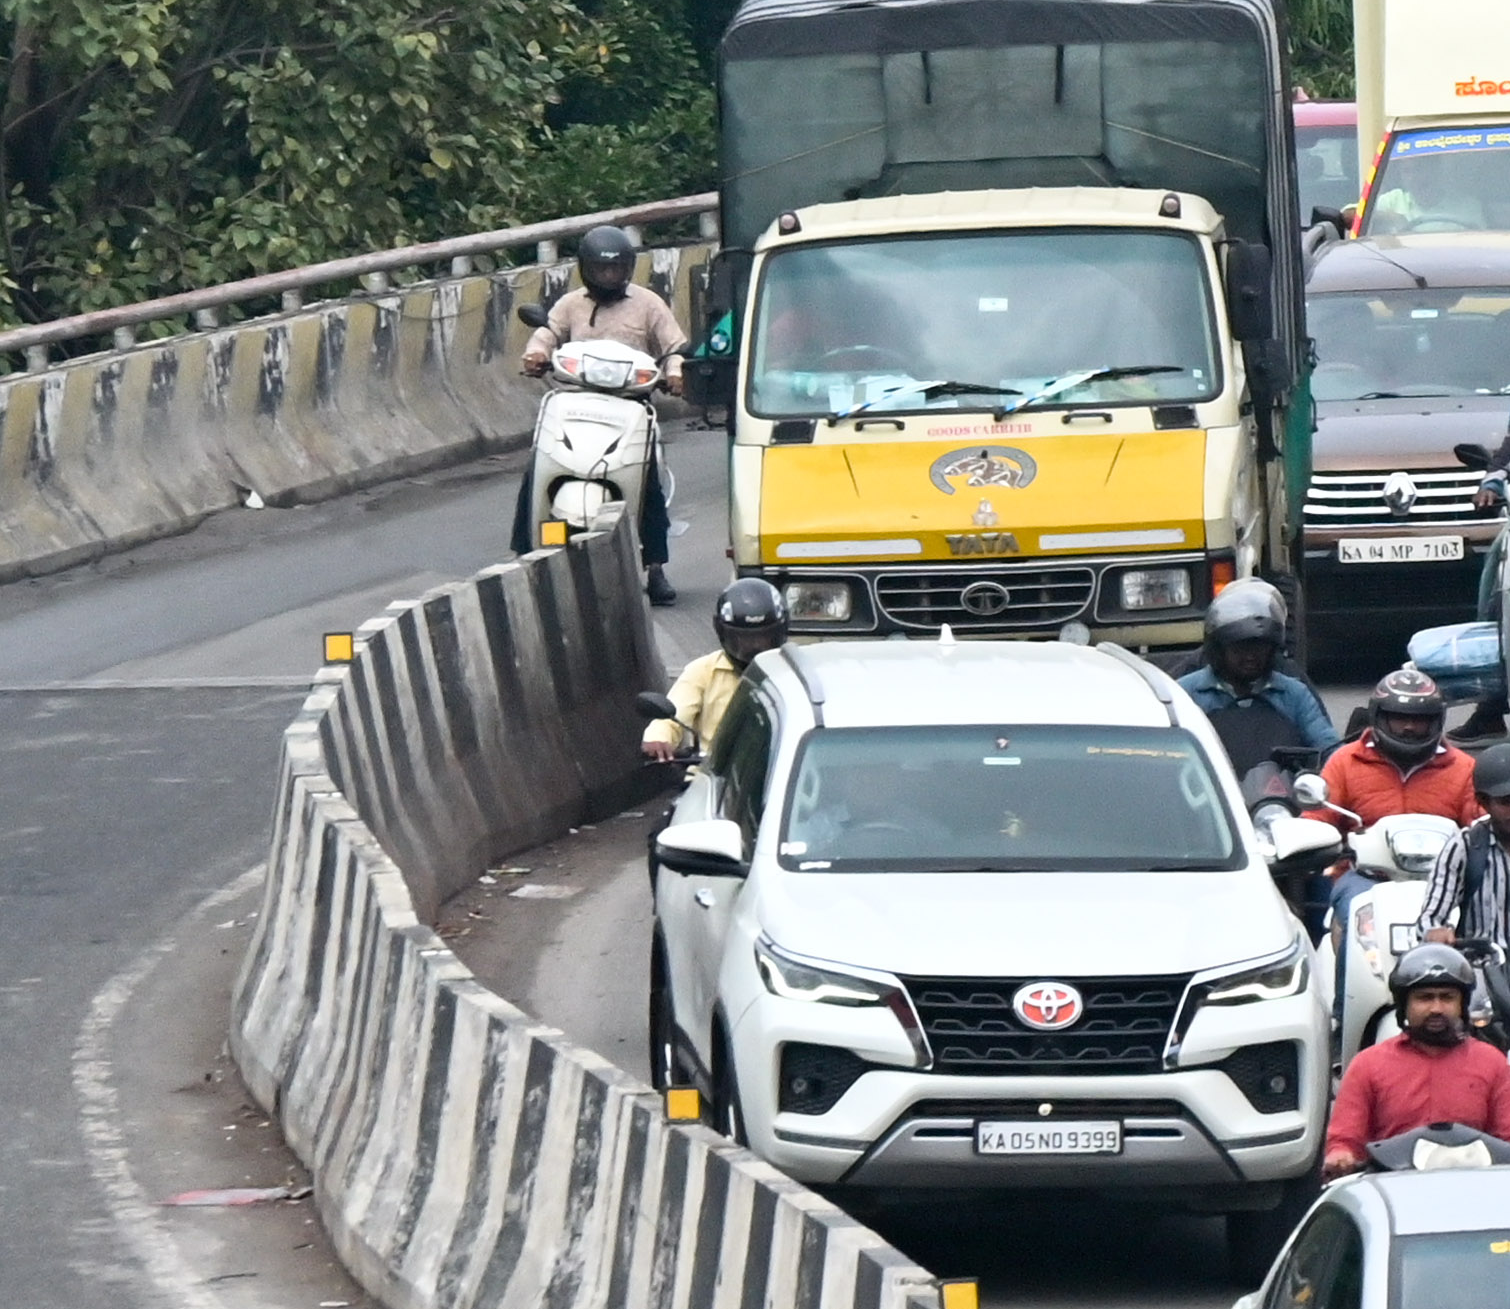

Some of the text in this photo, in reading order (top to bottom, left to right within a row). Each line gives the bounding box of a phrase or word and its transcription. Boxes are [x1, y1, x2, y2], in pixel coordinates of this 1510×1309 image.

[927, 427, 971, 437] GOODS
[945, 532, 1019, 555] TATA
[1341, 545, 1363, 560] KA
[1369, 544, 1384, 559] 04
[1390, 544, 1414, 559] MP
